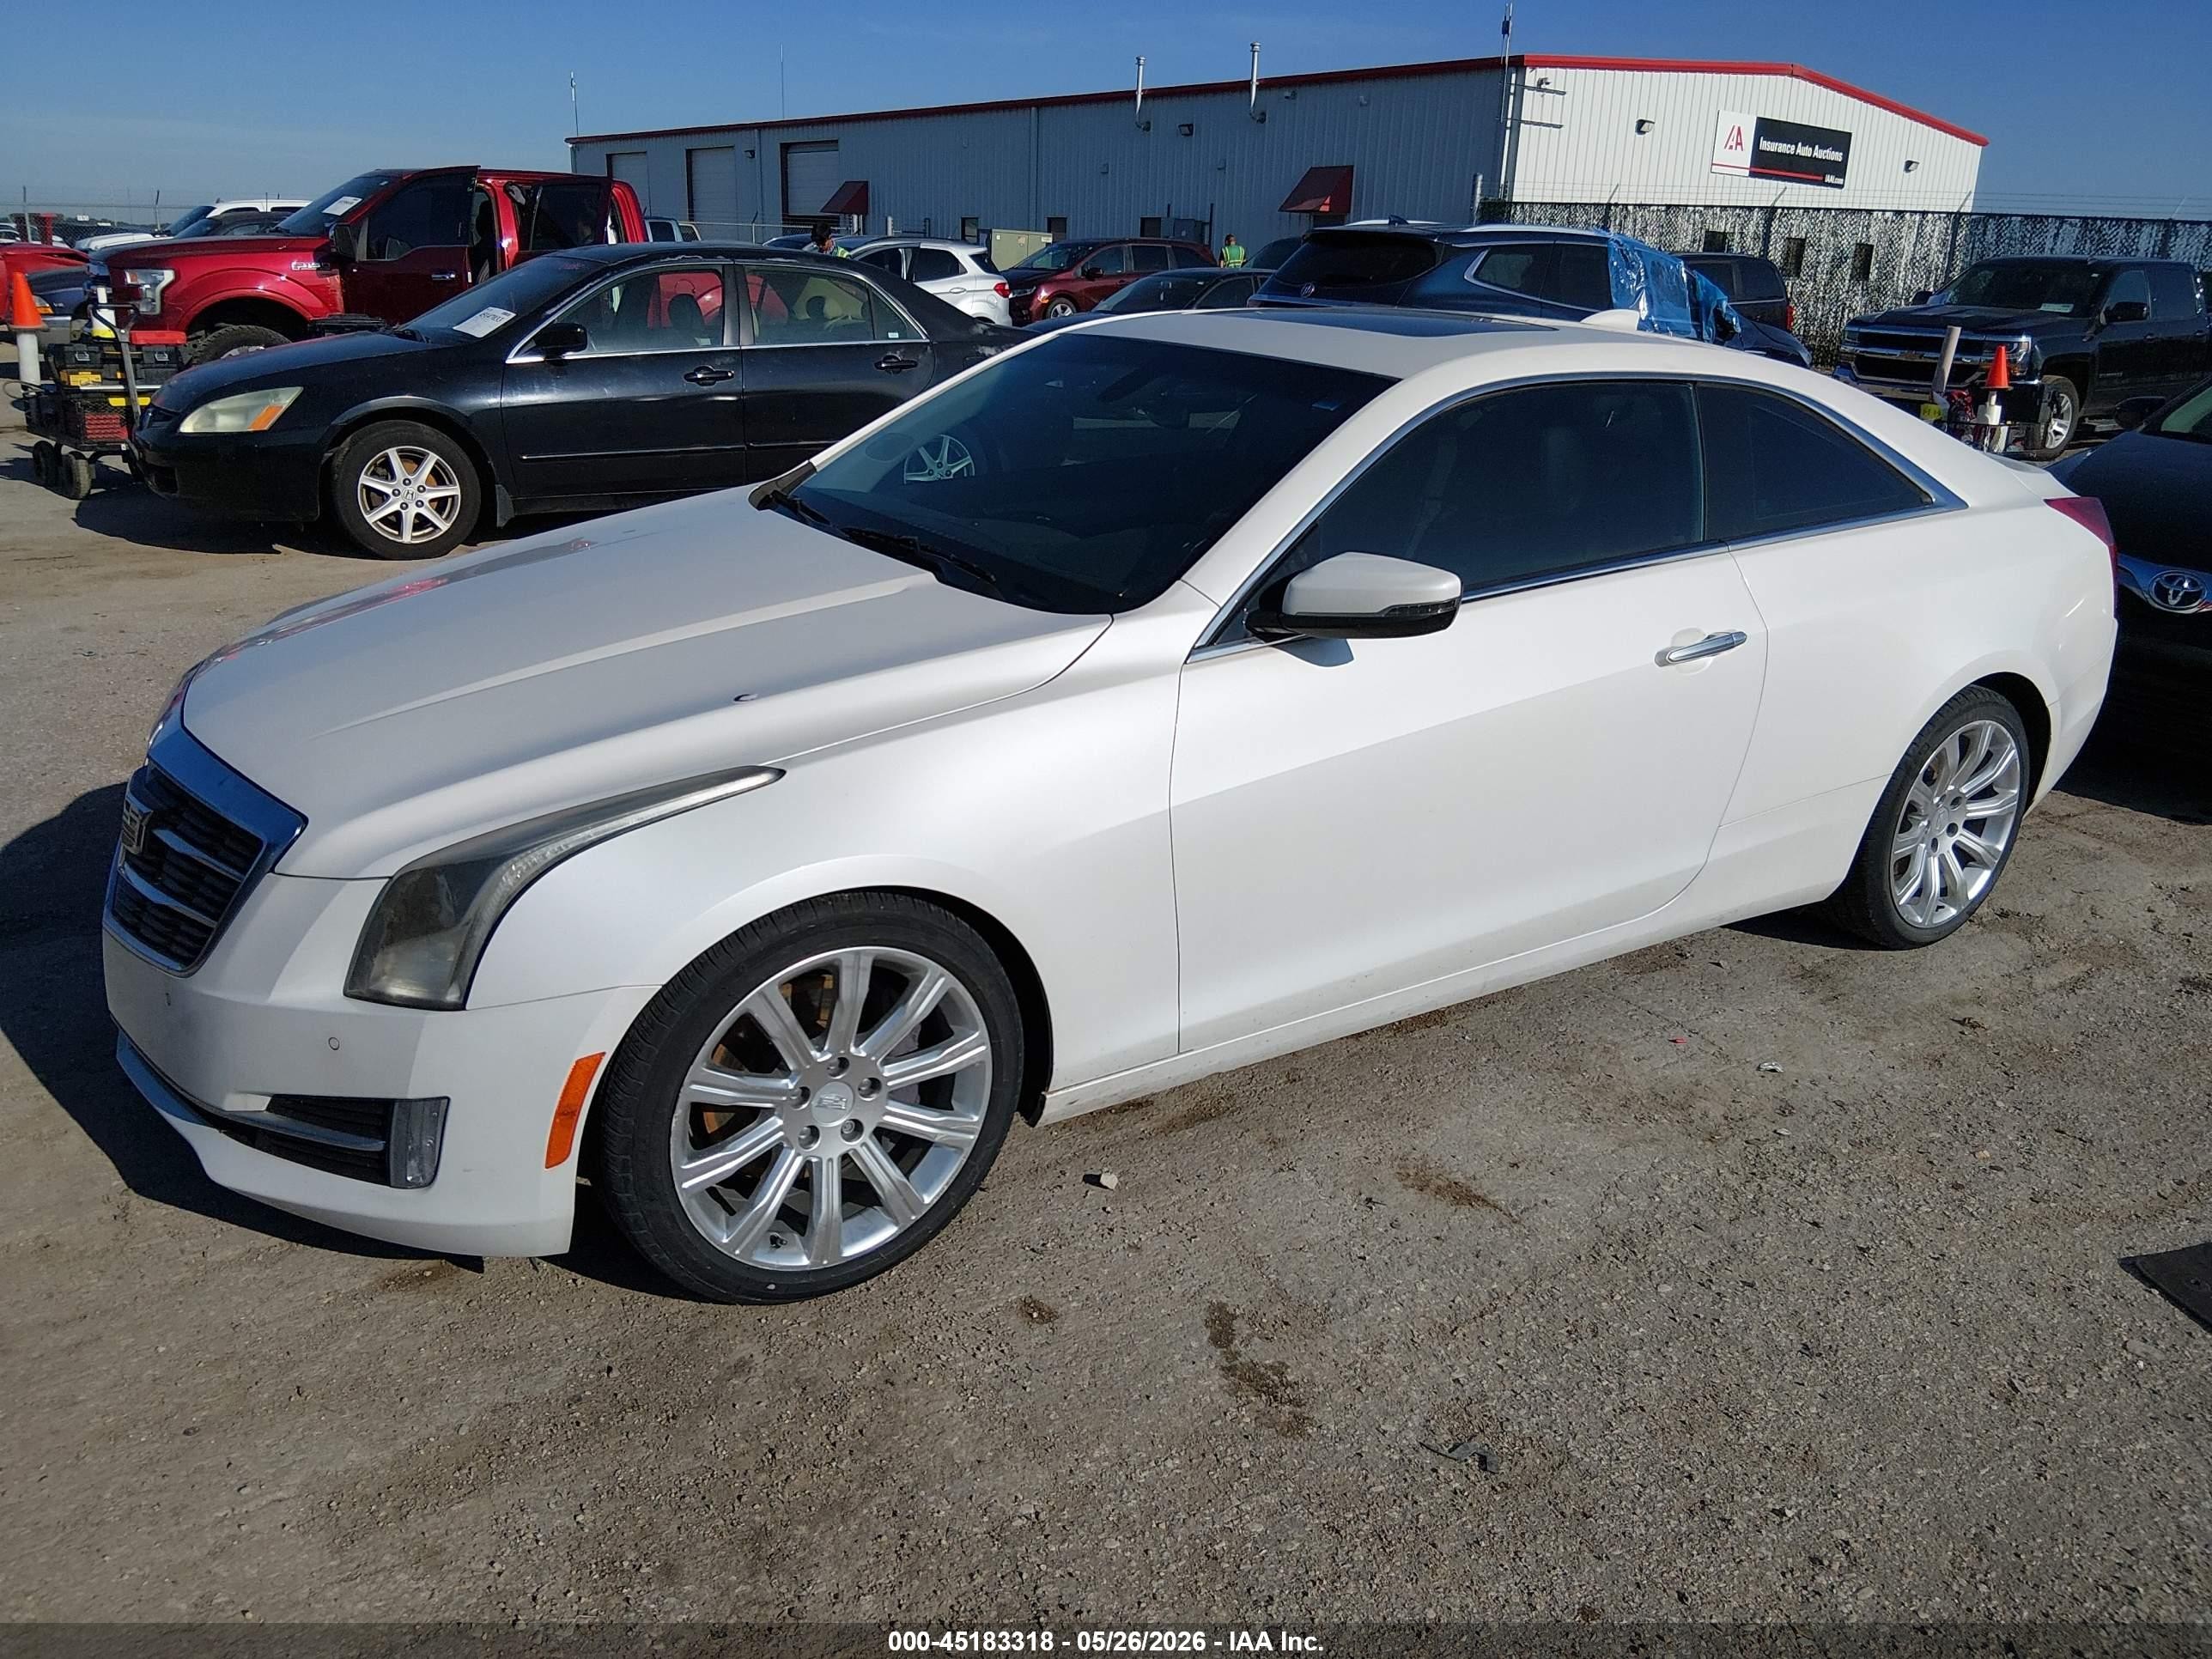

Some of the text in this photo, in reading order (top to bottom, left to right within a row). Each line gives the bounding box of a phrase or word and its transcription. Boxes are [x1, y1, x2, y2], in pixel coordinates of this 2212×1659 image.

[1759, 136, 1844, 162] Insurance Auto Auctions
